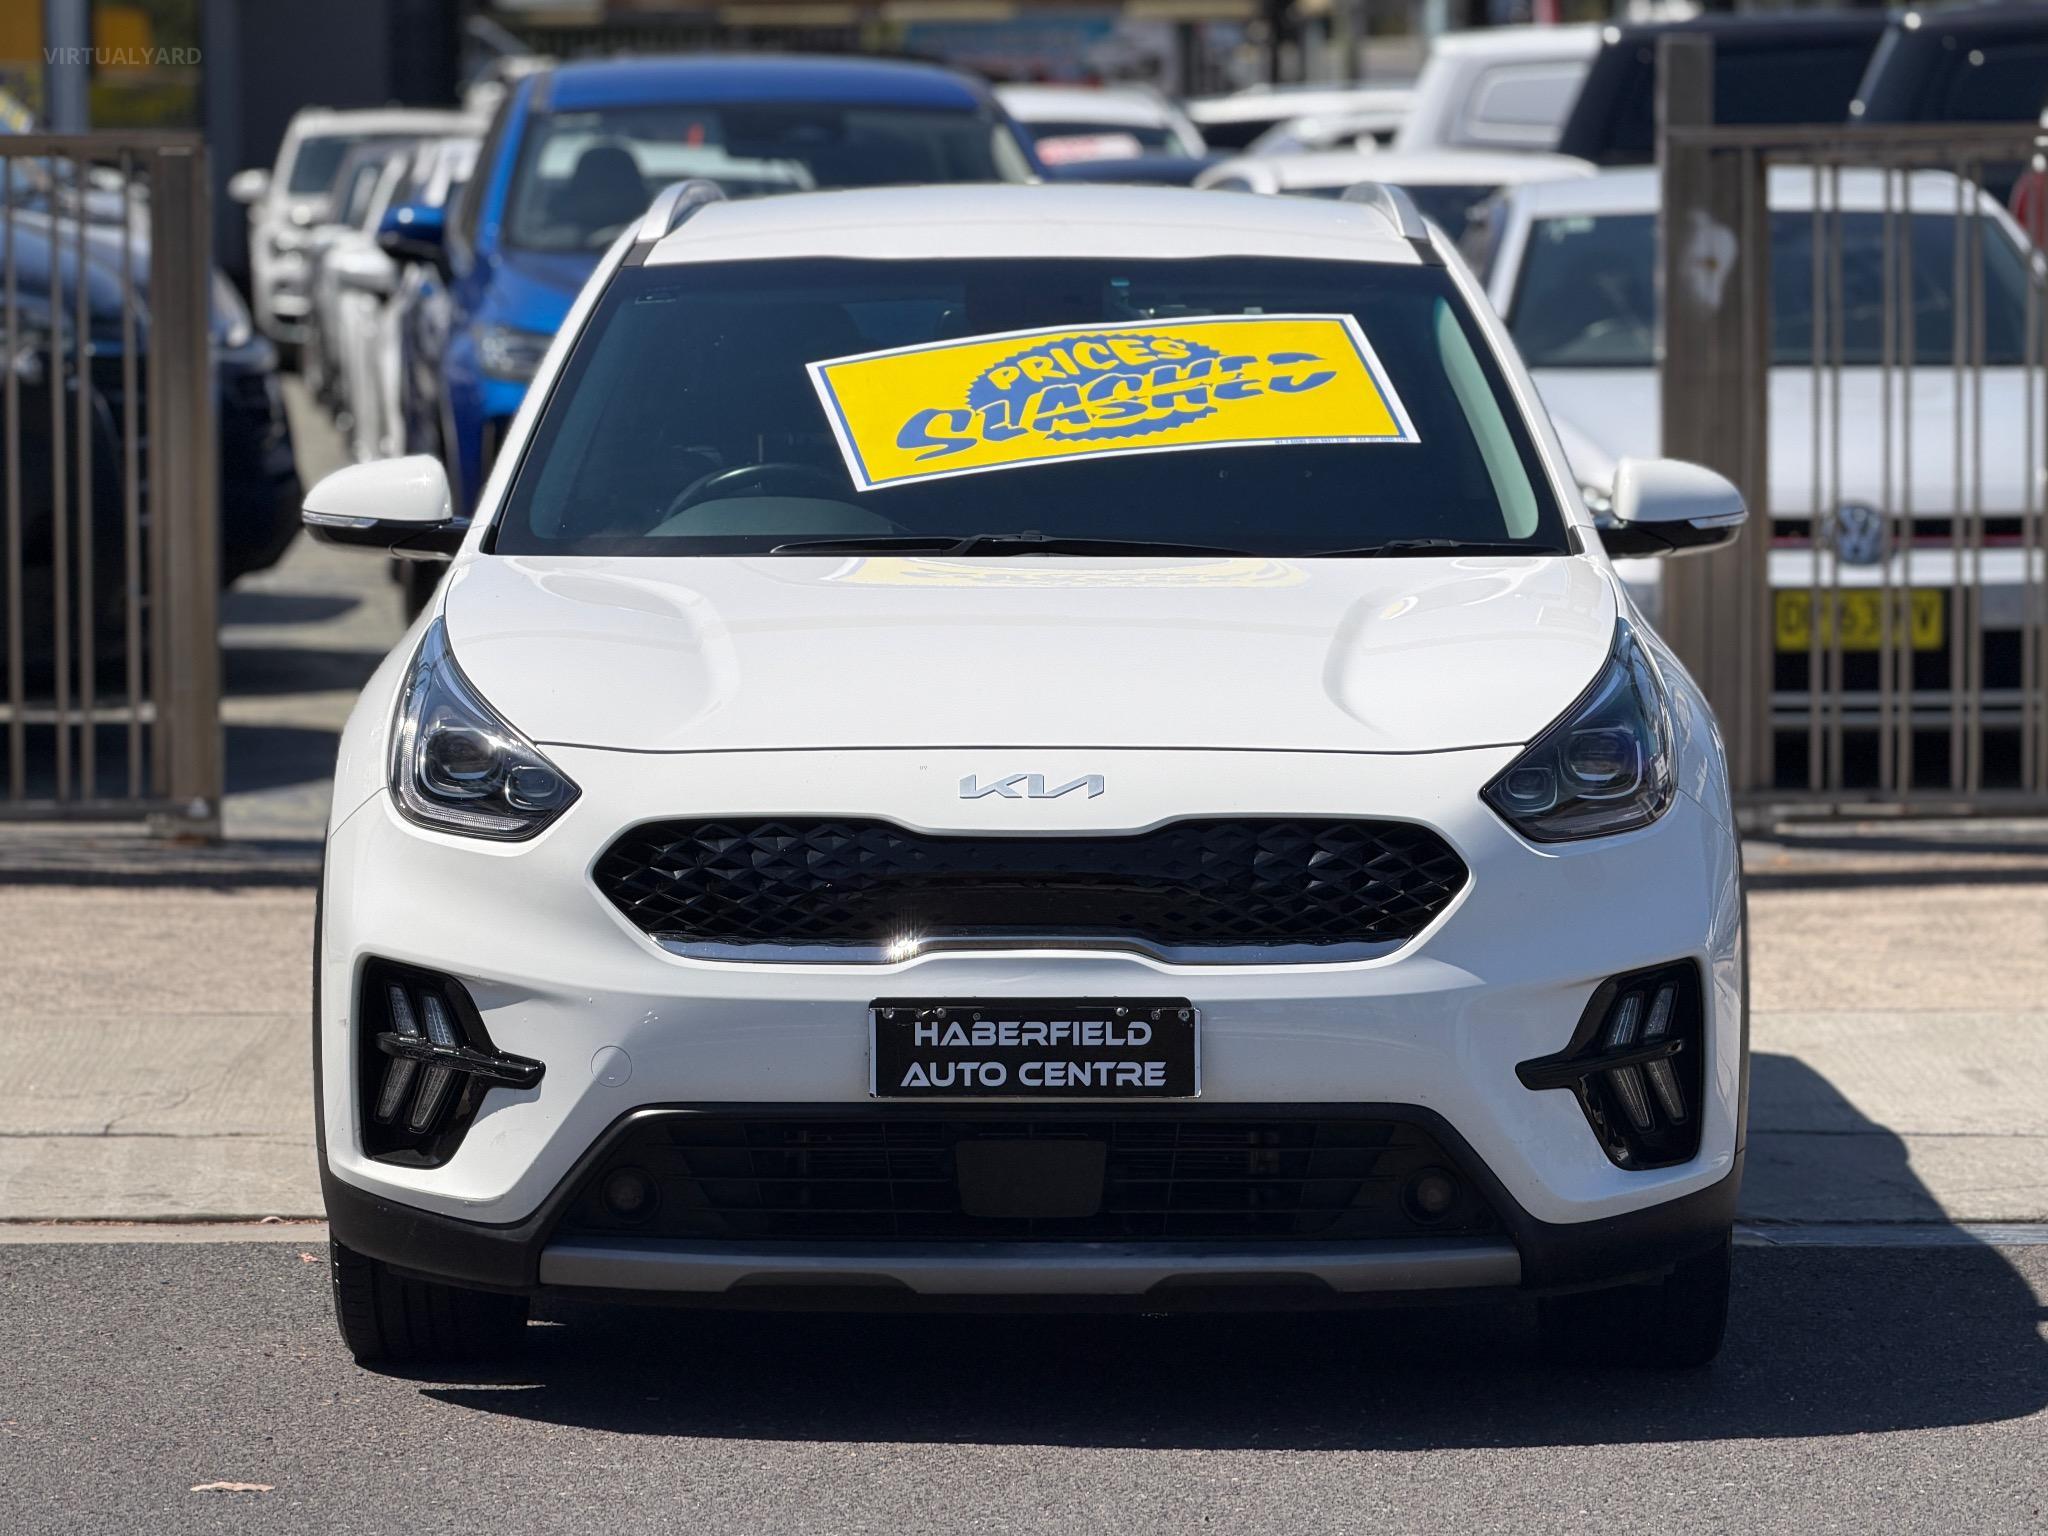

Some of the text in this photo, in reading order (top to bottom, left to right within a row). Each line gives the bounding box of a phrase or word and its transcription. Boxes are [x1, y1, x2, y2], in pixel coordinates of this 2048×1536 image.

[986, 338, 1190, 390] PRICES
[895, 352, 1337, 461] SLASHED
[959, 773, 1105, 800] KIA
[913, 1021, 1153, 1047] HABERFIELD
[900, 1061, 1167, 1087] AUTO CENTRE
